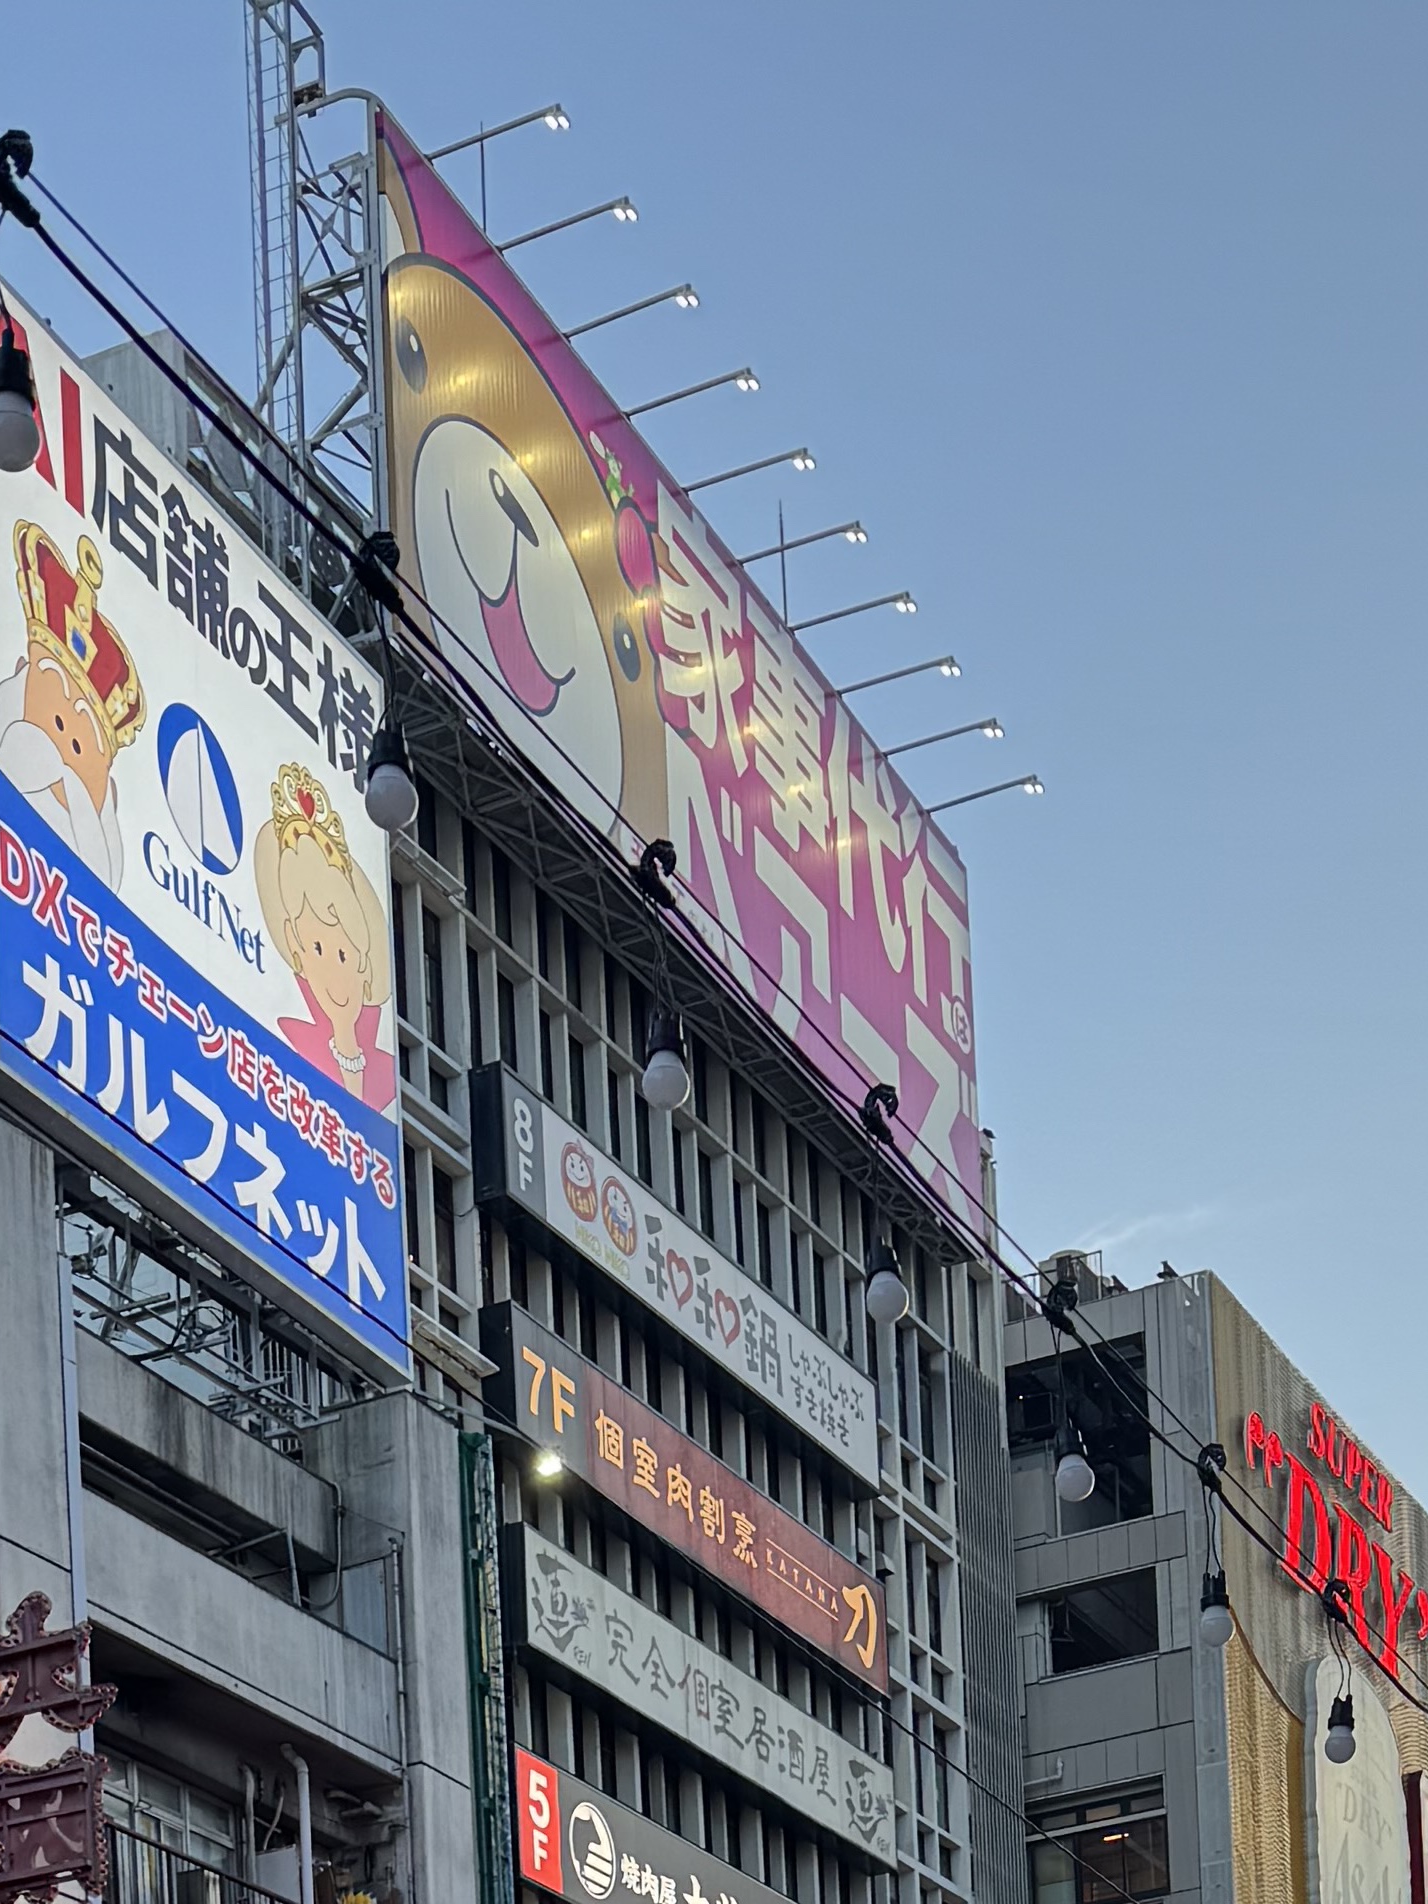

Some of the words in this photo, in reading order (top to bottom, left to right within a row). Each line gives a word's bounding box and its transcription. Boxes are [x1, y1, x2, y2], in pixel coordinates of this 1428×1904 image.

[21, 951, 388, 1314] ガルフネット
[512, 1097, 534, 1192] 8F
[522, 1345, 576, 1434] 7F
[787, 1333, 865, 1422] しゃぶしゃぶ
[790, 1376, 851, 1449] すき焼き
[594, 1408, 758, 1570] 個室肉割烹
[1309, 1402, 1393, 1534] SUPER
[841, 1583, 878, 1669] 刀
[605, 1608, 838, 1807] 完全個室居酒屋
[528, 1767, 553, 1873] 5F
